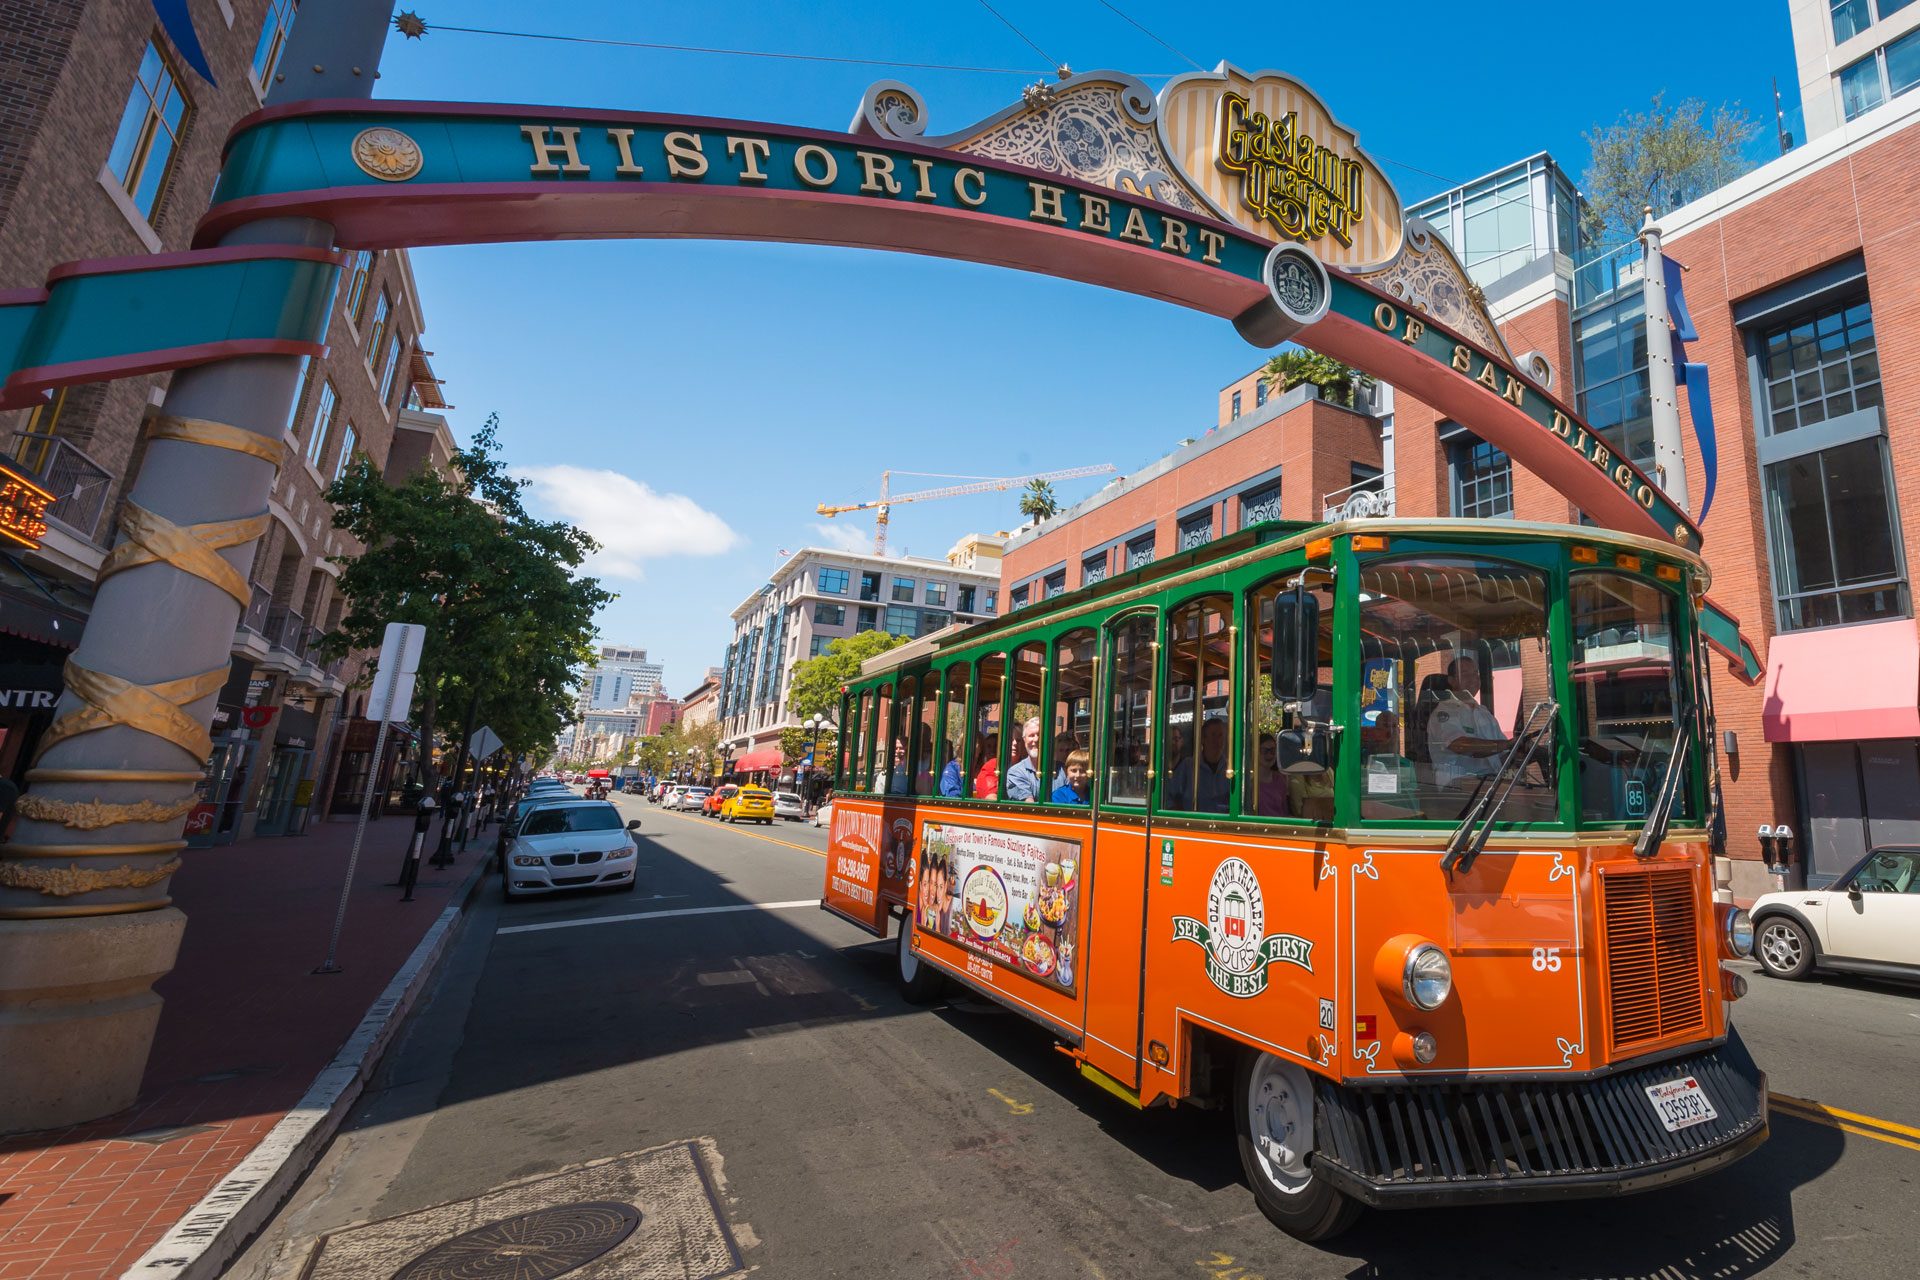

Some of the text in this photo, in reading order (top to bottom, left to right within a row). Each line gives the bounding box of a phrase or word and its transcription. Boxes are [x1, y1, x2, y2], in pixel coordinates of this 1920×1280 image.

[1219, 92, 1364, 222] Gaslamp
[1246, 158, 1352, 243] Quarter
[520, 125, 1655, 509] HISTORIC HEART OF SAN DIEGO
[1629, 791, 1642, 805] 85
[945, 832, 1046, 862] Discover Old Town's Famous Sizzling Fajitas
[1024, 860, 1036, 870] Brunch
[1011, 887, 1021, 897] Sports
[1210, 862, 1262, 931] OLD TOWN TROLLEY
[1178, 920, 1307, 962] SEE FIRST
[1216, 933, 1255, 969] TOURS
[1208, 958, 1264, 994] THE BEST
[1532, 947, 1562, 972] 85
[1321, 1006, 1332, 1027] 20
[1658, 1085, 1690, 1098] California
[1660, 1093, 1711, 1123] 13593P1
[176, 1211, 230, 1238] MIN
[206, 1178, 262, 1205] MAX
